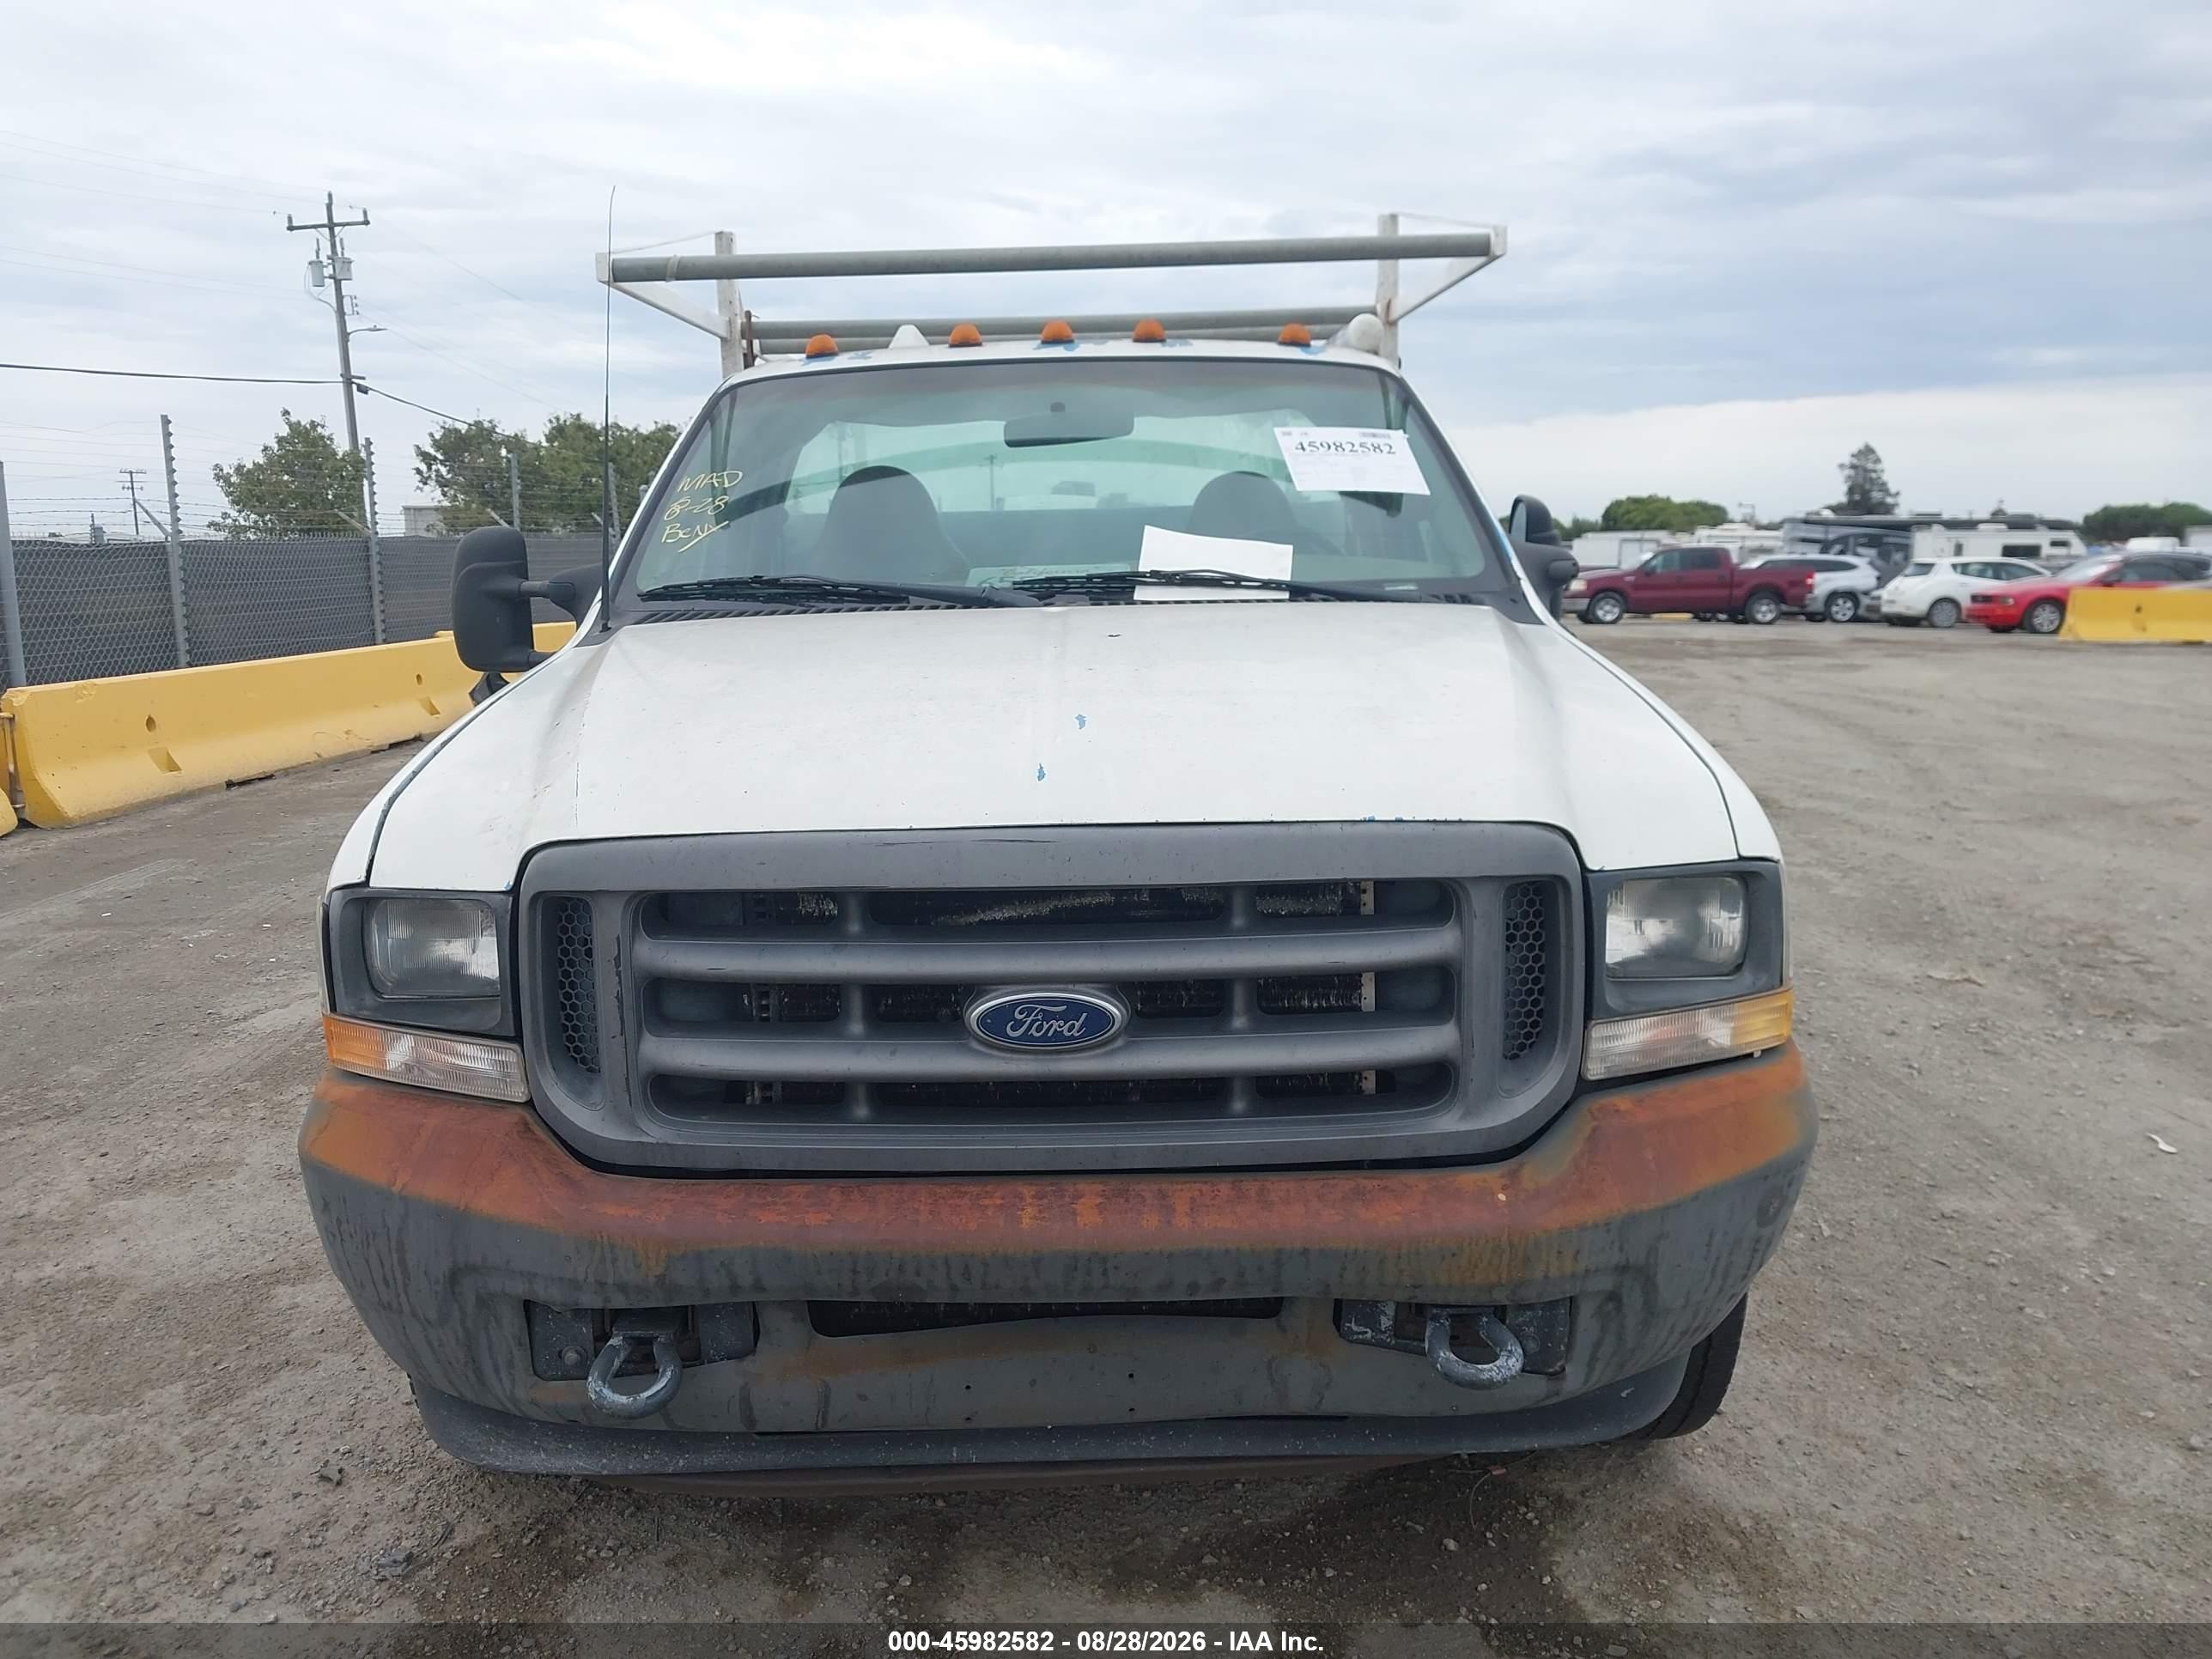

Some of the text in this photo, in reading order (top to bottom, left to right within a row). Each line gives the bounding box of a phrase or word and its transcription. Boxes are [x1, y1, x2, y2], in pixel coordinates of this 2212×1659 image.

[1294, 441, 1396, 455] 45982582
[664, 495, 730, 521] 8-28
[1006, 1004, 1089, 1037] Ford
